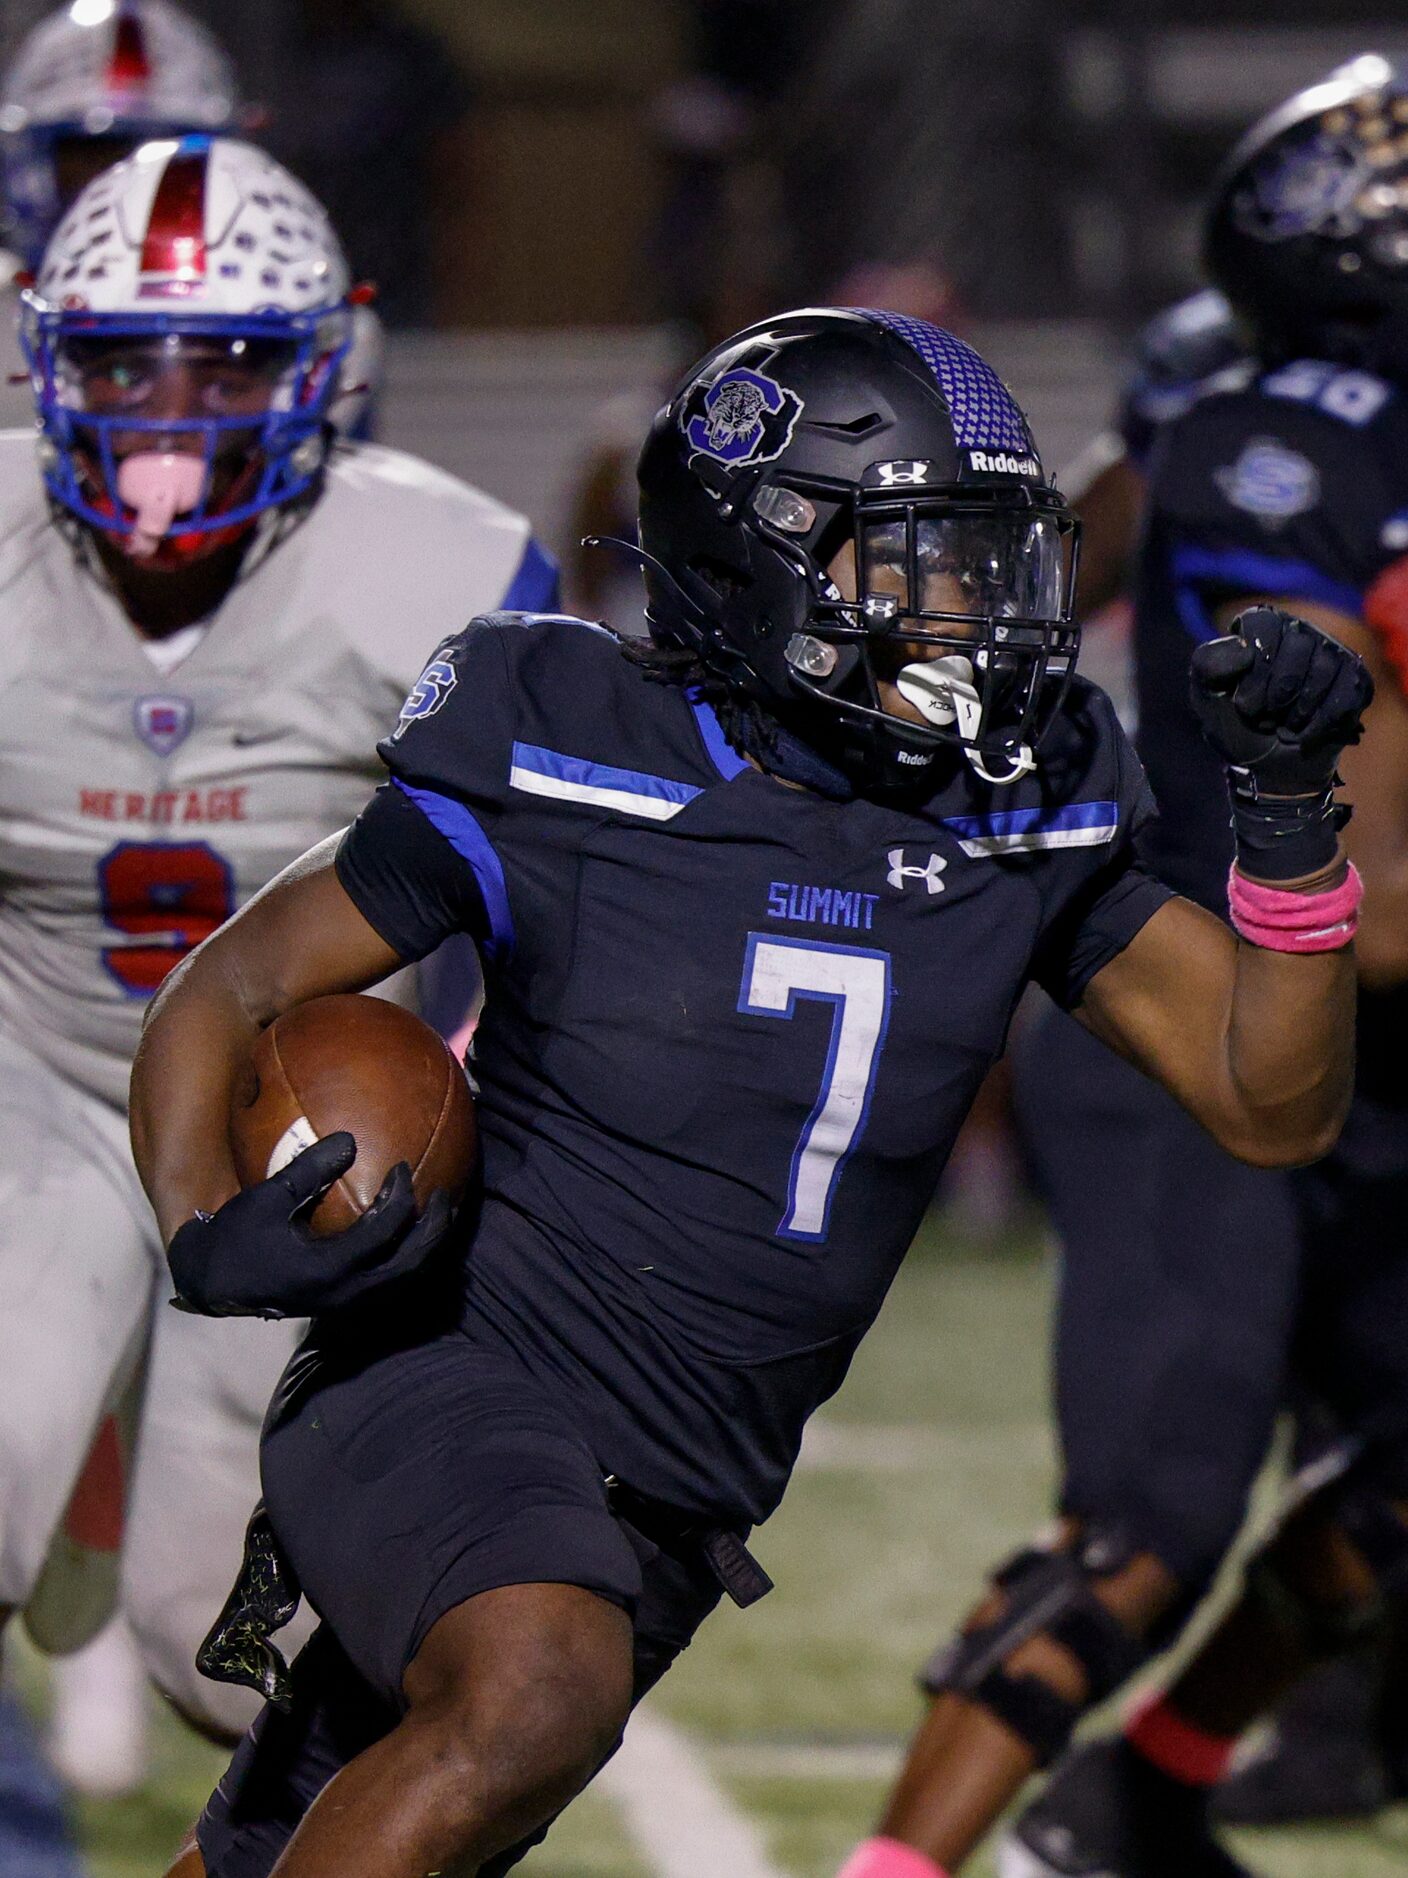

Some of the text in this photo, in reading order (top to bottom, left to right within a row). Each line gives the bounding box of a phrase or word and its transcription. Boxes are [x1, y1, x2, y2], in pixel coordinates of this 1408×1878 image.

[969, 450, 1038, 477] Riddell
[79, 785, 249, 823] HERITAGE
[97, 838, 236, 1000] 9
[767, 881, 879, 929] SUMMIT
[737, 931, 891, 1243] 7
